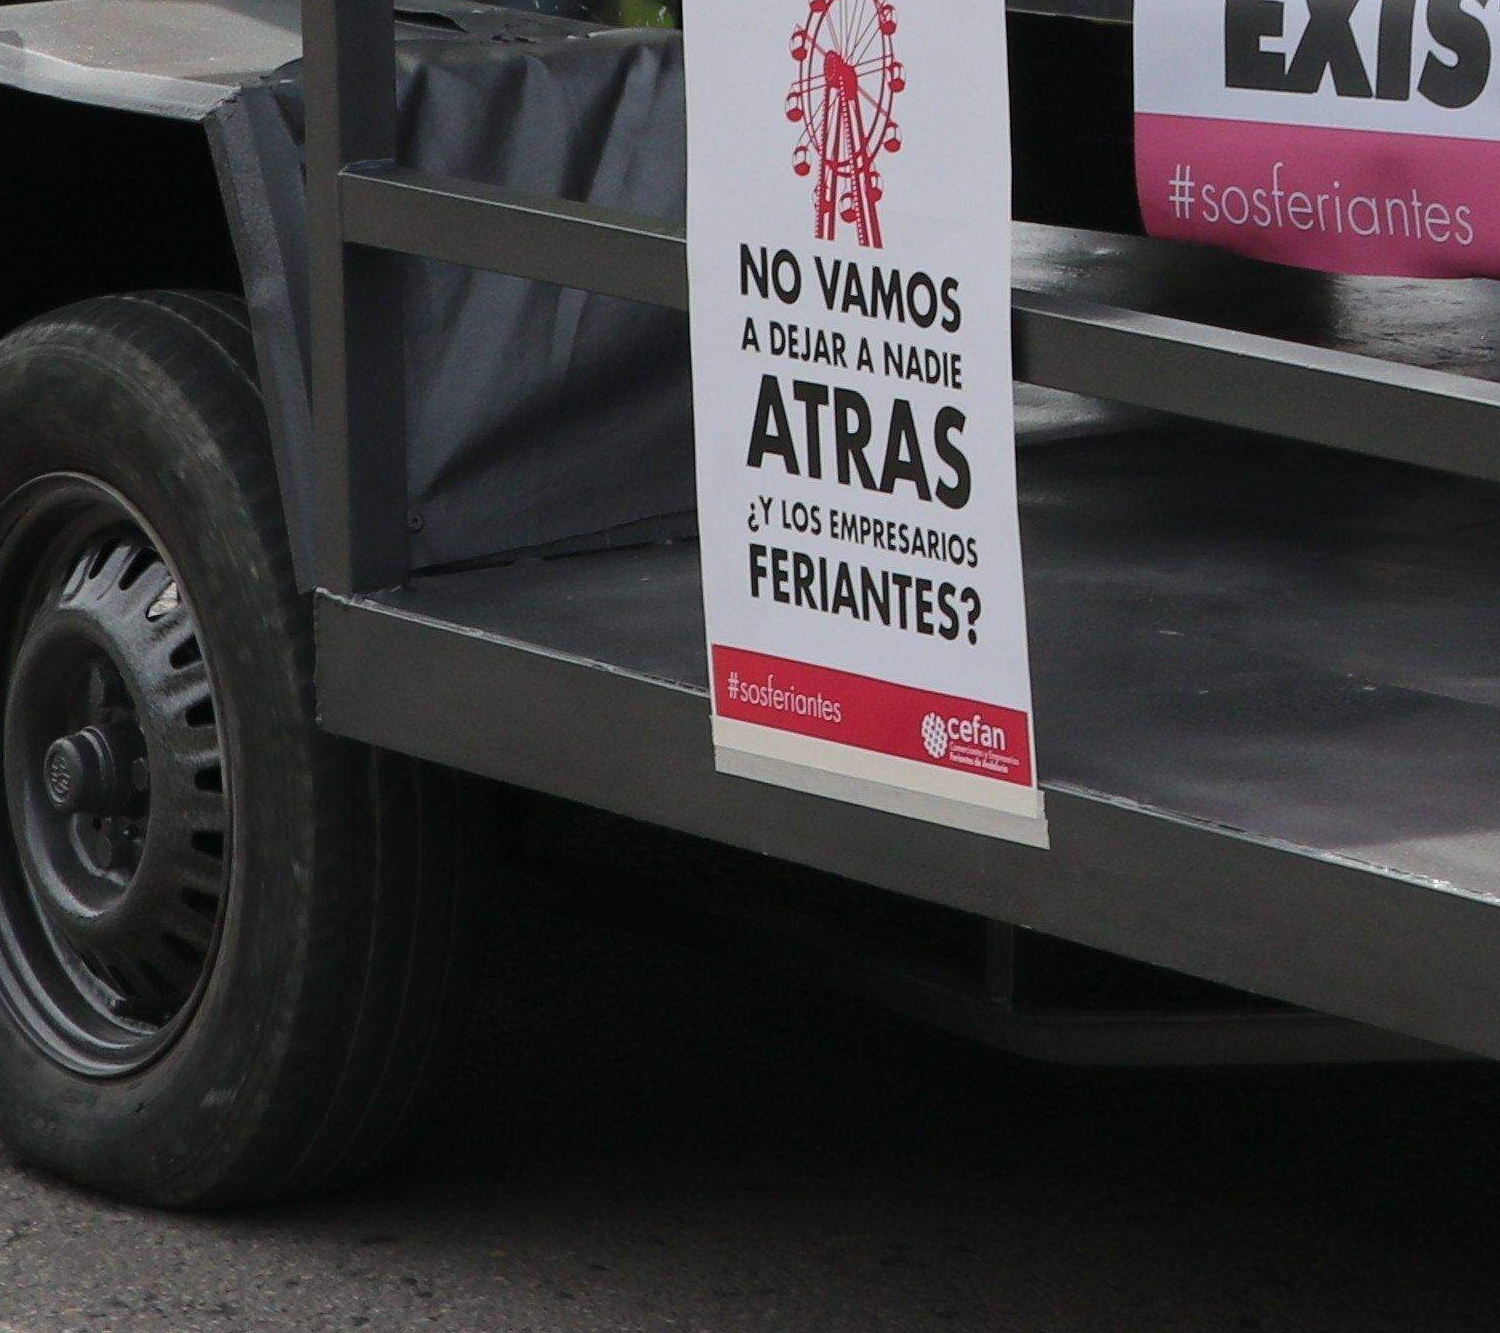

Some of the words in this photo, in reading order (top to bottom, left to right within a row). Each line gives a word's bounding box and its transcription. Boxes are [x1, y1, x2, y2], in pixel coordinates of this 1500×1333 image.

[1168, 161, 1475, 248] #sosferiantes
[739, 243, 801, 305] NO
[814, 256, 962, 333] VAMOS
[741, 316, 760, 352] A
[768, 322, 847, 369] DEJAR
[856, 336, 874, 373] A
[883, 341, 963, 391] NADIE
[746, 374, 973, 510] ATRAS
[747, 496, 773, 532] ¿Y
[781, 500, 821, 535] LOS
[829, 507, 979, 569] EMPRESARIOS
[748, 543, 982, 646] FERIANTES?
[727, 671, 841, 723] #sosferiantes
[947, 713, 1006, 751] cefan
